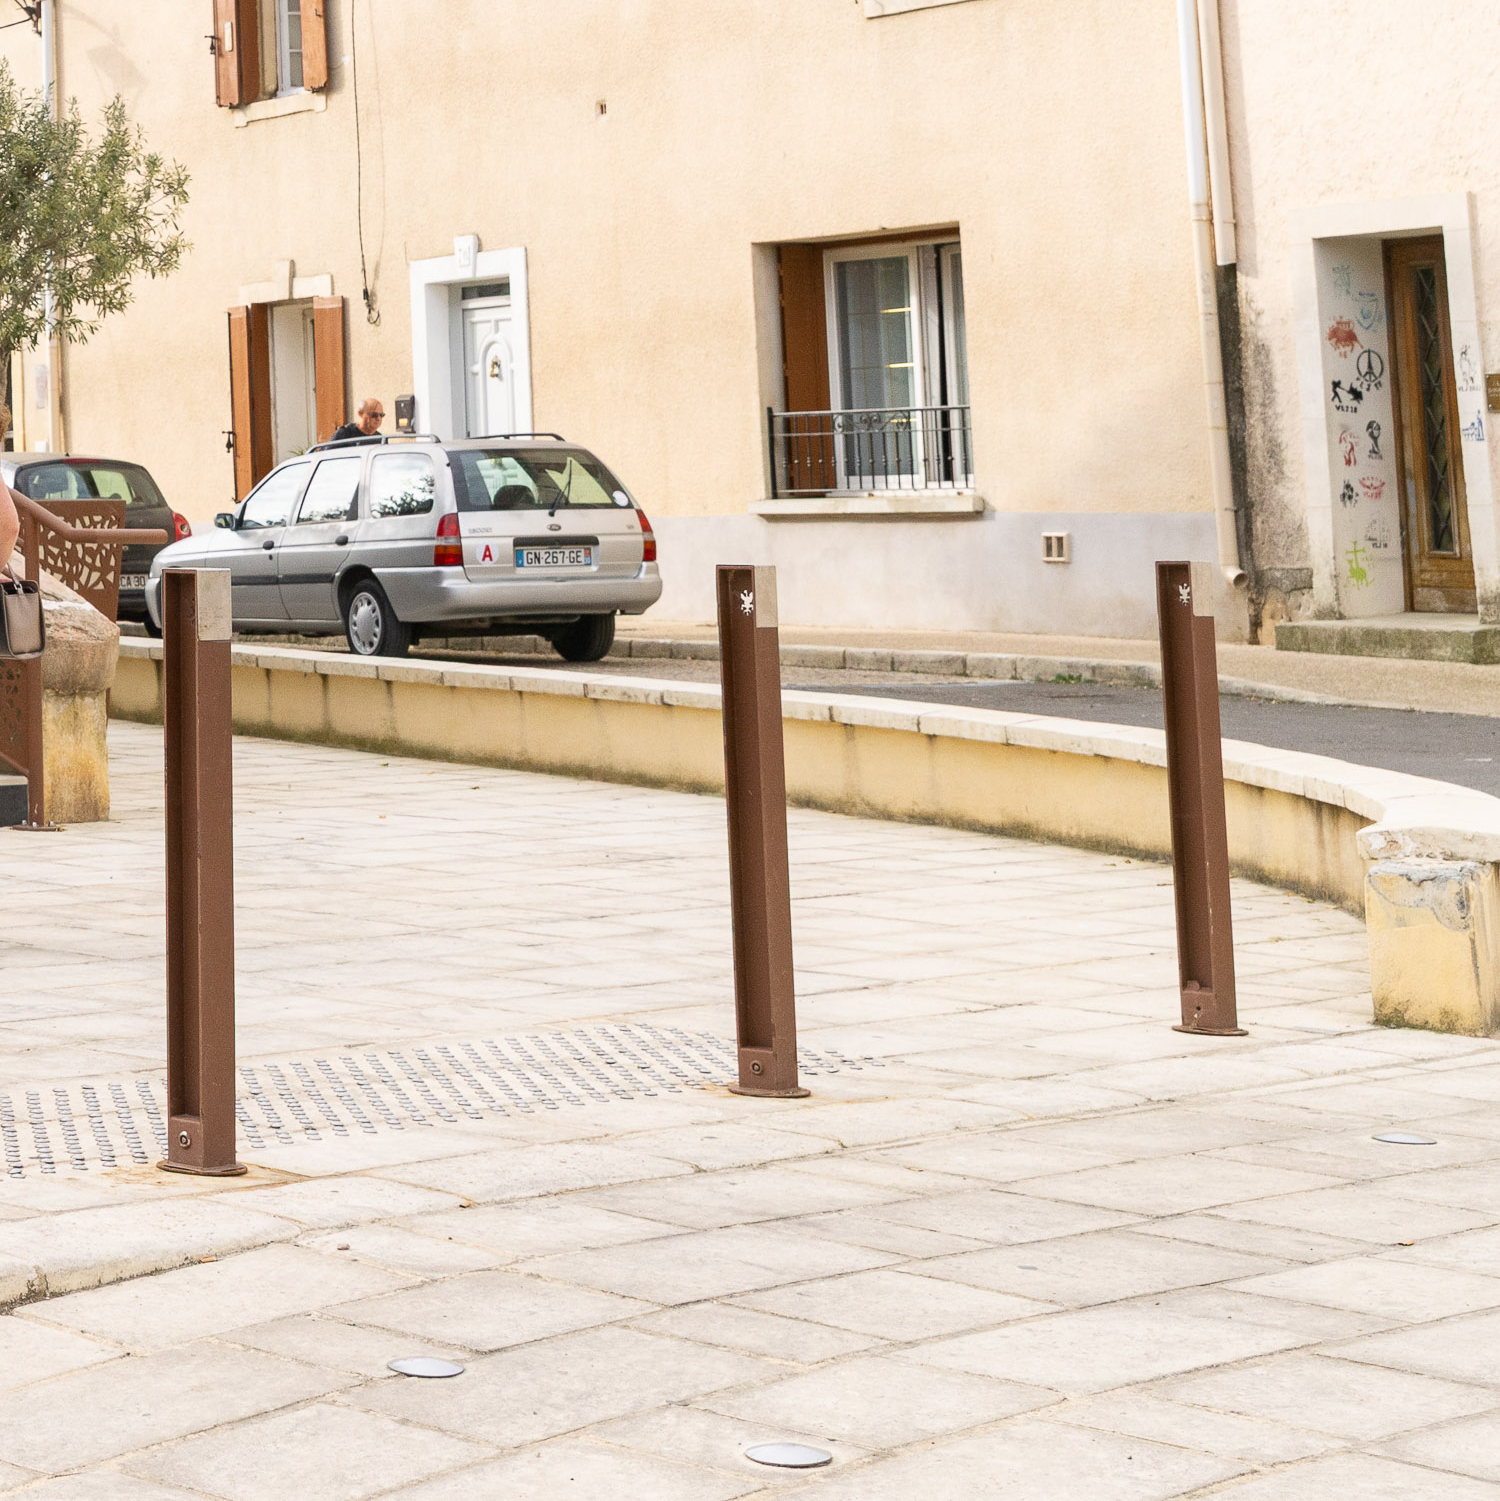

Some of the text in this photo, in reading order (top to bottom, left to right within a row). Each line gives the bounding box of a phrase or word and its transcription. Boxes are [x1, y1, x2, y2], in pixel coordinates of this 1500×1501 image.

[481, 544, 493, 562] A
[526, 550, 583, 565] GN-267-GE
[133, 575, 146, 587] 30
